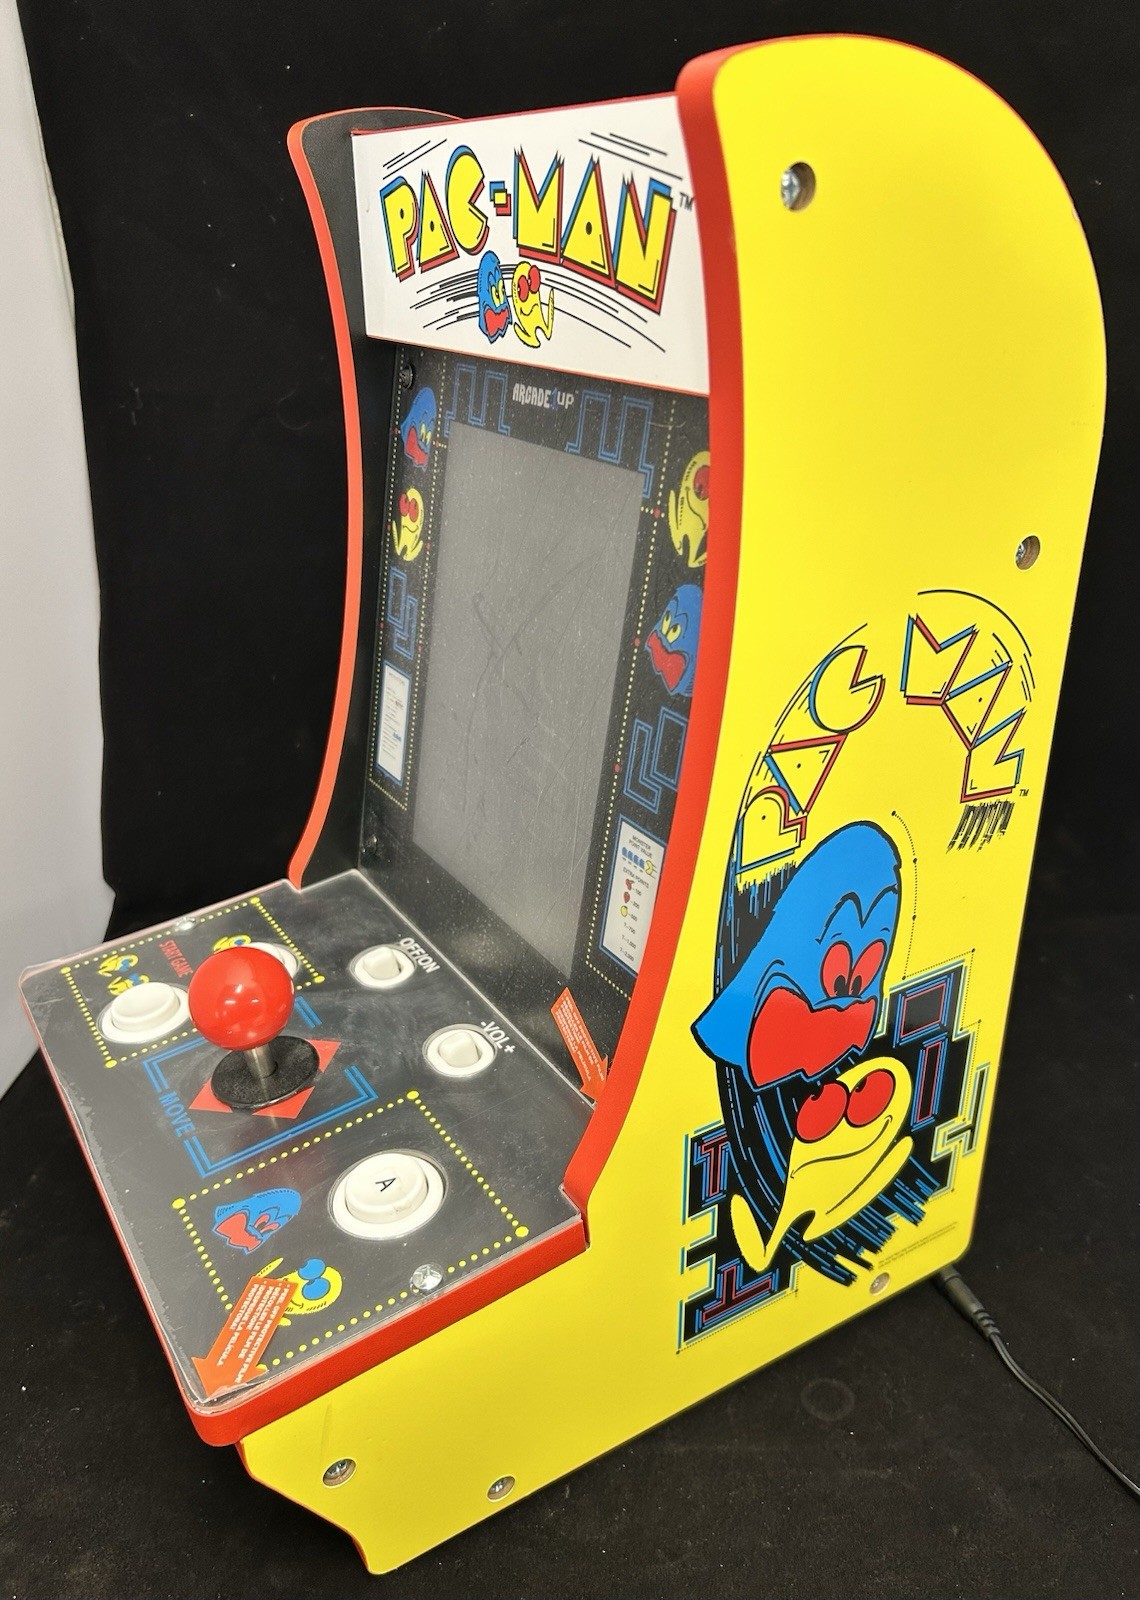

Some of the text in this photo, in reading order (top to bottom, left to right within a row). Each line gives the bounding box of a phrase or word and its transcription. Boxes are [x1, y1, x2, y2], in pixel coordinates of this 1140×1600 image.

[379, 143, 677, 316] PAC-MAN
[736, 645, 886, 875] PAC
[900, 613, 1026, 804] MAN
[159, 939, 193, 977] START GAME
[399, 937, 440, 974] OFF/ON
[158, 1090, 196, 1138] MOVE
[374, 1177, 397, 1192] A
[275, 1288, 289, 1304] PEEL
[268, 1305, 280, 1319] OFF
[235, 1321, 245, 1331] LA
[252, 1321, 262, 1331] LE
[243, 1331, 256, 1347] FILM
[244, 1319, 272, 1363] PROTECTIVE
[237, 1348, 247, 1358] DE
